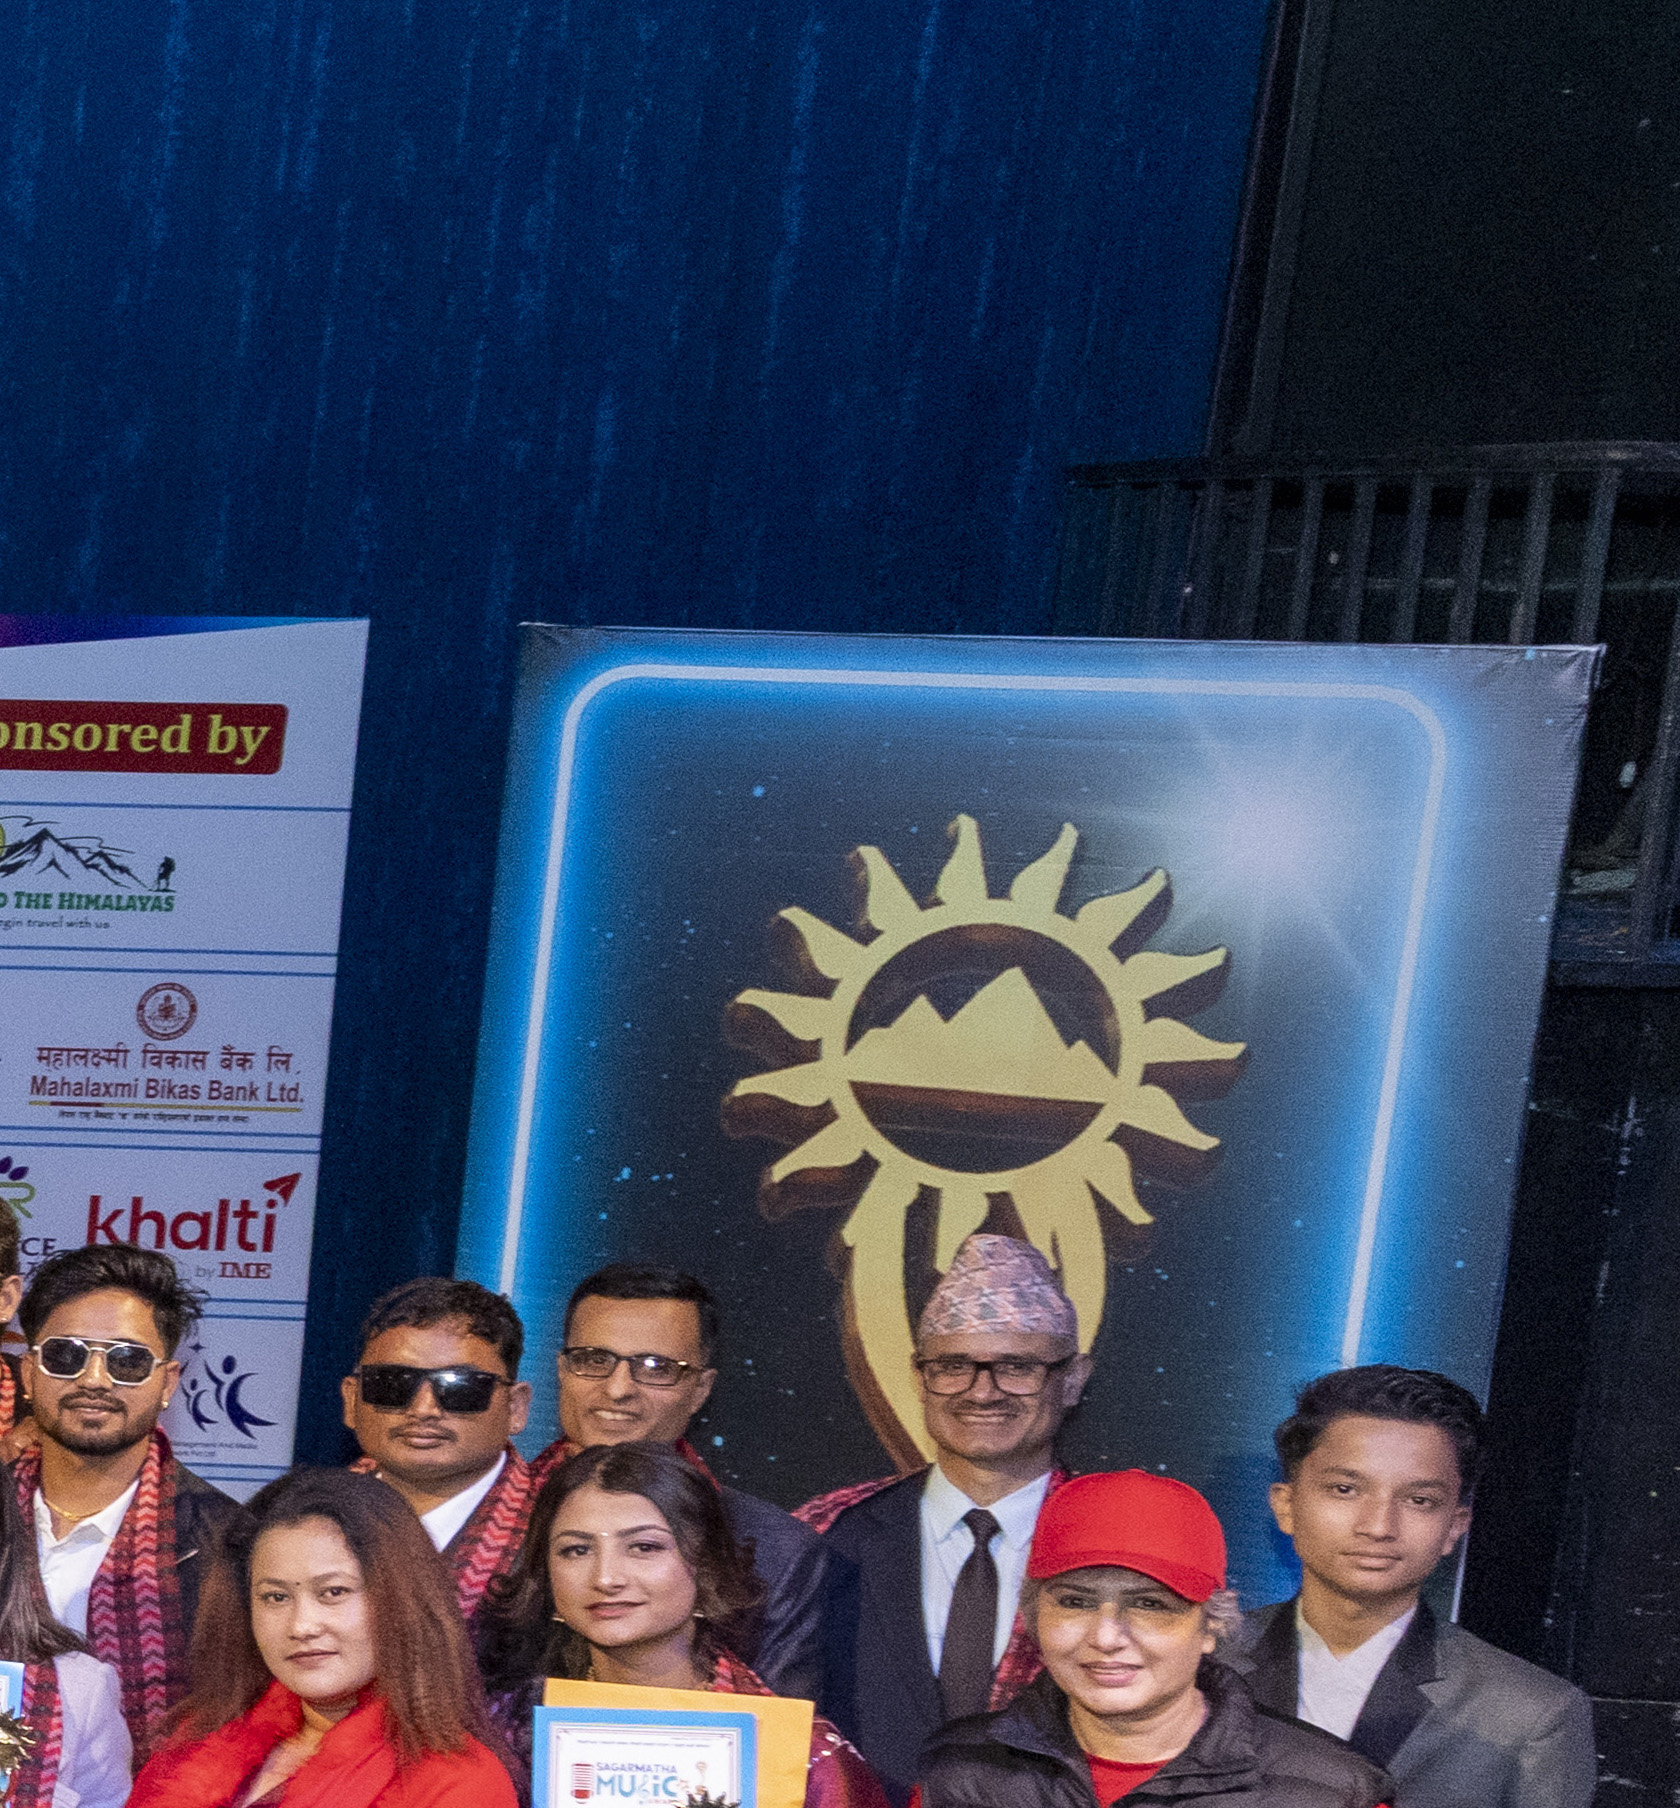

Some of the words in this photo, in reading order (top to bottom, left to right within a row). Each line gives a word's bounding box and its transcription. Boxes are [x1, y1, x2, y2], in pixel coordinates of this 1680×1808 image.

[207, 714, 271, 765] by
[13, 891, 54, 909] THE
[57, 892, 176, 912] HIMALAYAS
[27, 916, 63, 928] travel
[66, 917, 92, 928] with
[95, 920, 110, 929] us
[36, 1042, 130, 1071] महालक्ष्मी
[141, 1042, 210, 1071] विकास
[30, 1075, 139, 1098] Mahalaxmi
[146, 1078, 201, 1100] Bikas
[208, 1080, 261, 1102] Bank
[267, 1082, 304, 1103] Ltd.
[86, 1194, 276, 1254] khalti
[217, 1261, 272, 1279] IME
[596, 1762, 678, 1774] SAGARMATHA
